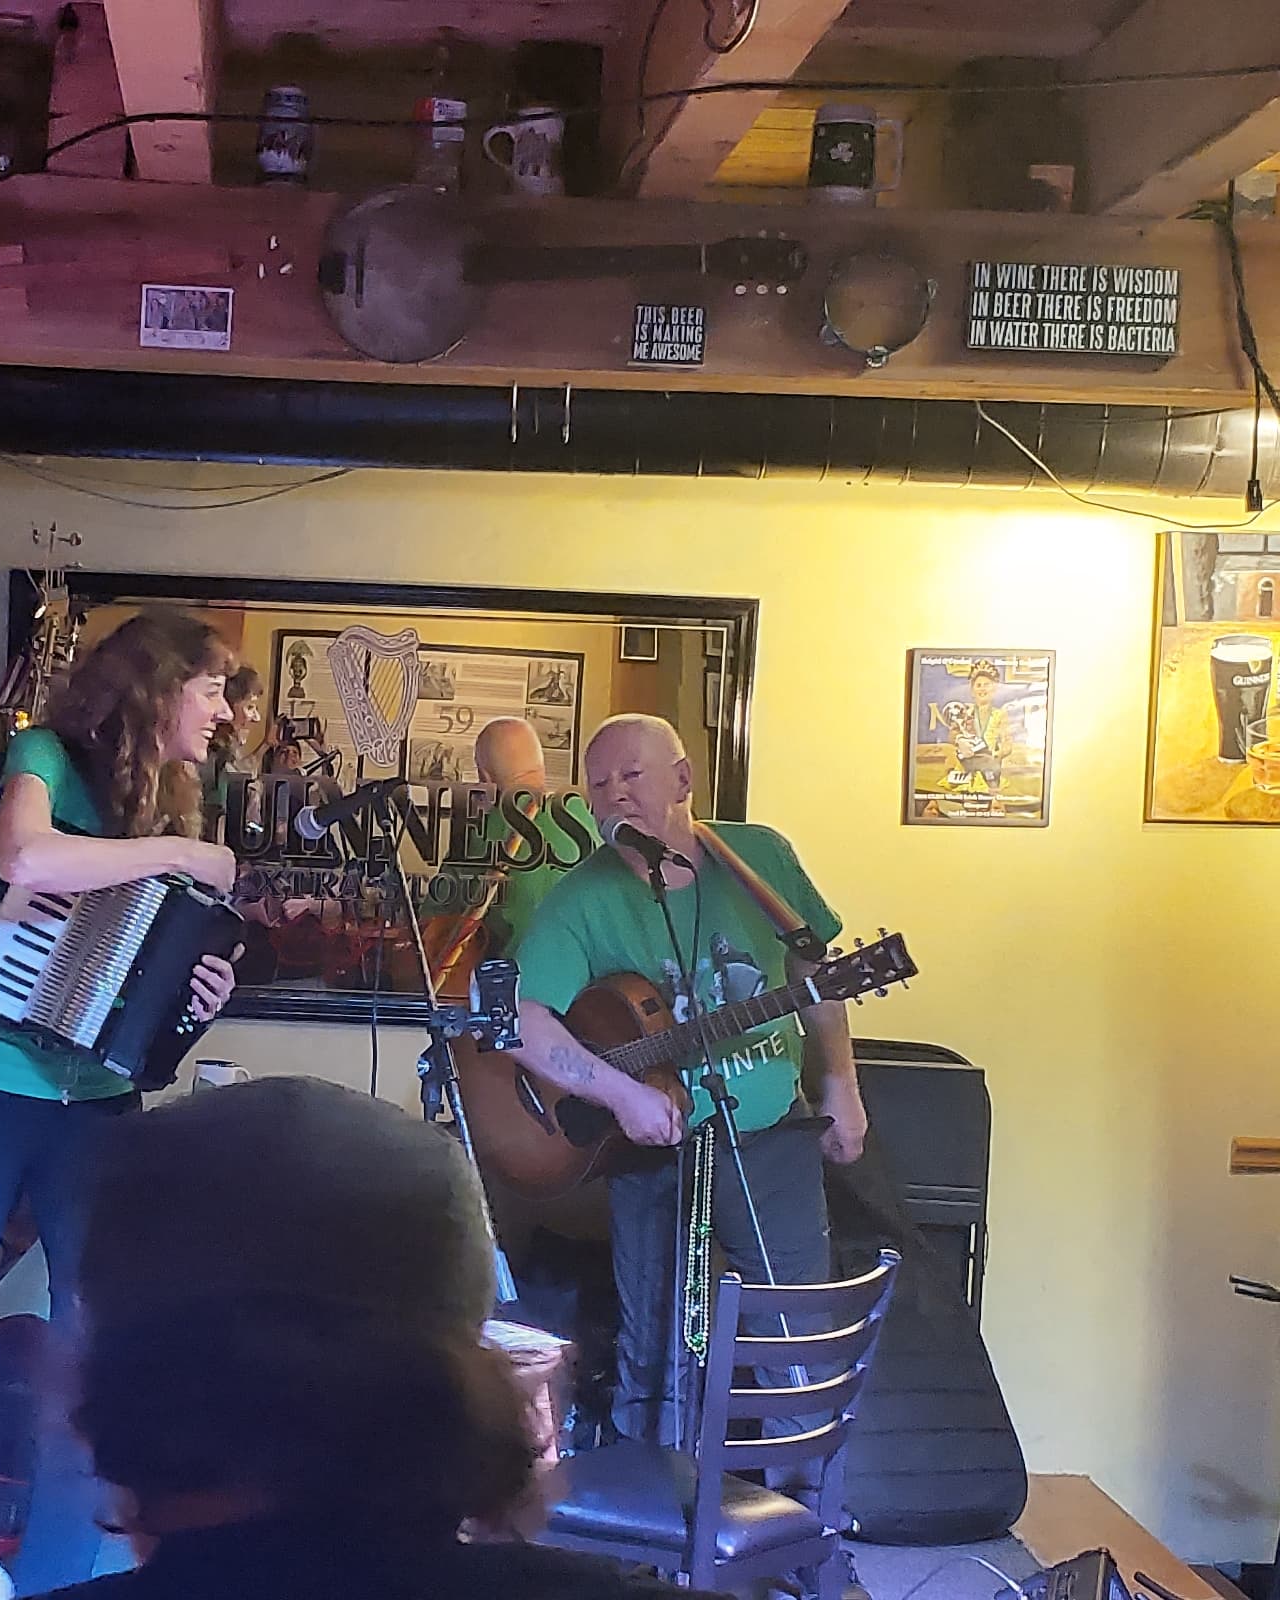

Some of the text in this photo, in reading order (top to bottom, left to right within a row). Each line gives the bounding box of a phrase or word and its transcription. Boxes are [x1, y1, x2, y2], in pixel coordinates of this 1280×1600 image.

[974, 263, 1178, 295] IN WINE THERE IS WISDOM
[636, 306, 703, 326] THIS BEER
[972, 291, 1176, 323] IN BEER THERE IS FREEDOM
[635, 324, 703, 343] IS MAKING
[970, 320, 1176, 352] IN WATER THERE IS BACTERIA
[633, 342, 702, 361] ME AWESOME
[436, 706, 474, 734] 59
[217, 773, 596, 872] UINNESS
